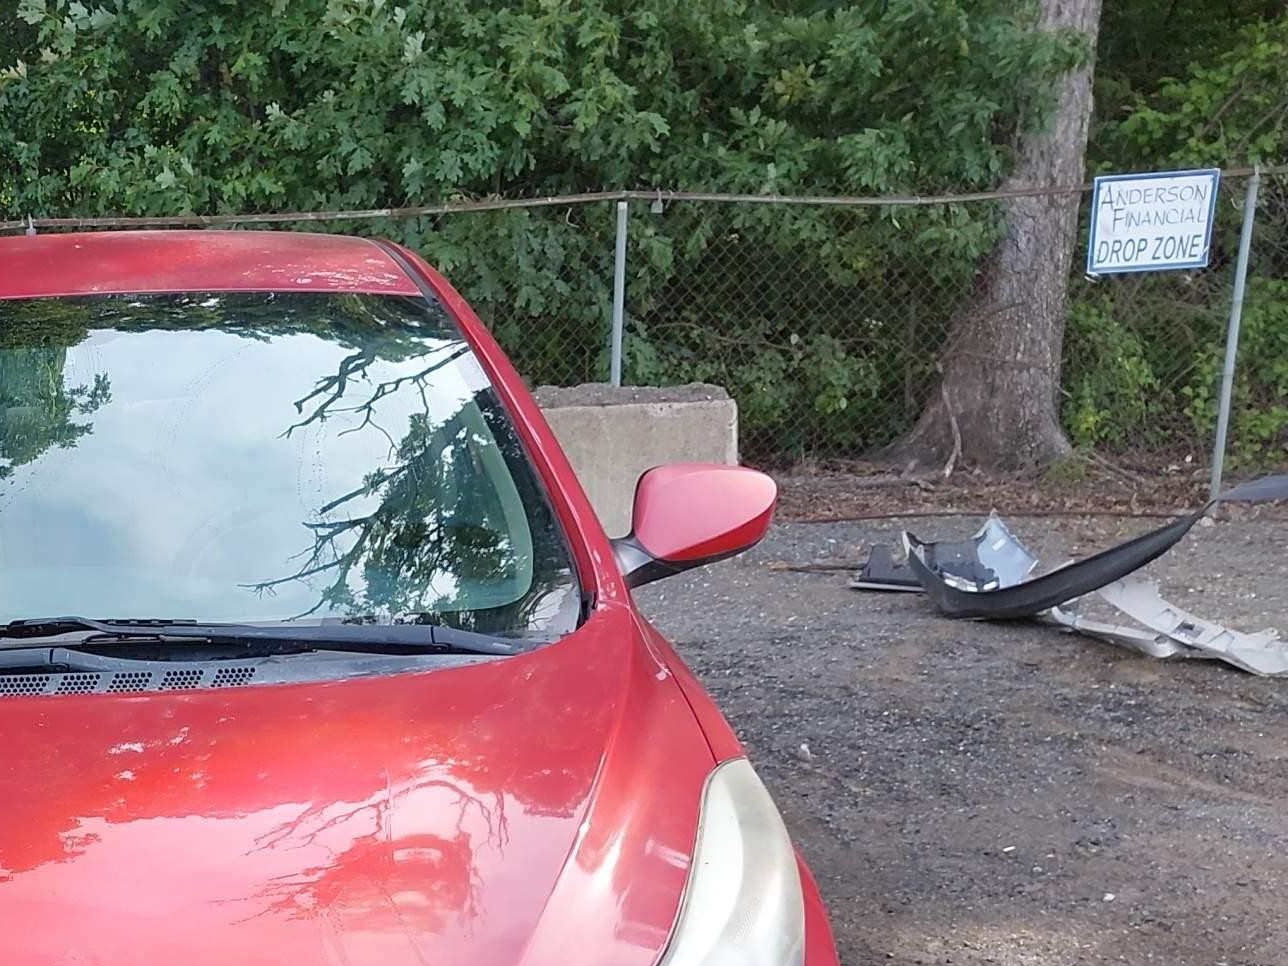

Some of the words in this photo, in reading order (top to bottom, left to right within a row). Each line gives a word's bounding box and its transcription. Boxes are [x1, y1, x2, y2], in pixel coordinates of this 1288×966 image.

[1100, 184, 1208, 210] ANDERSON
[1112, 207, 1206, 232] FINANCIAL
[1096, 238, 1148, 264] DROP
[1151, 234, 1203, 260] ZONE
